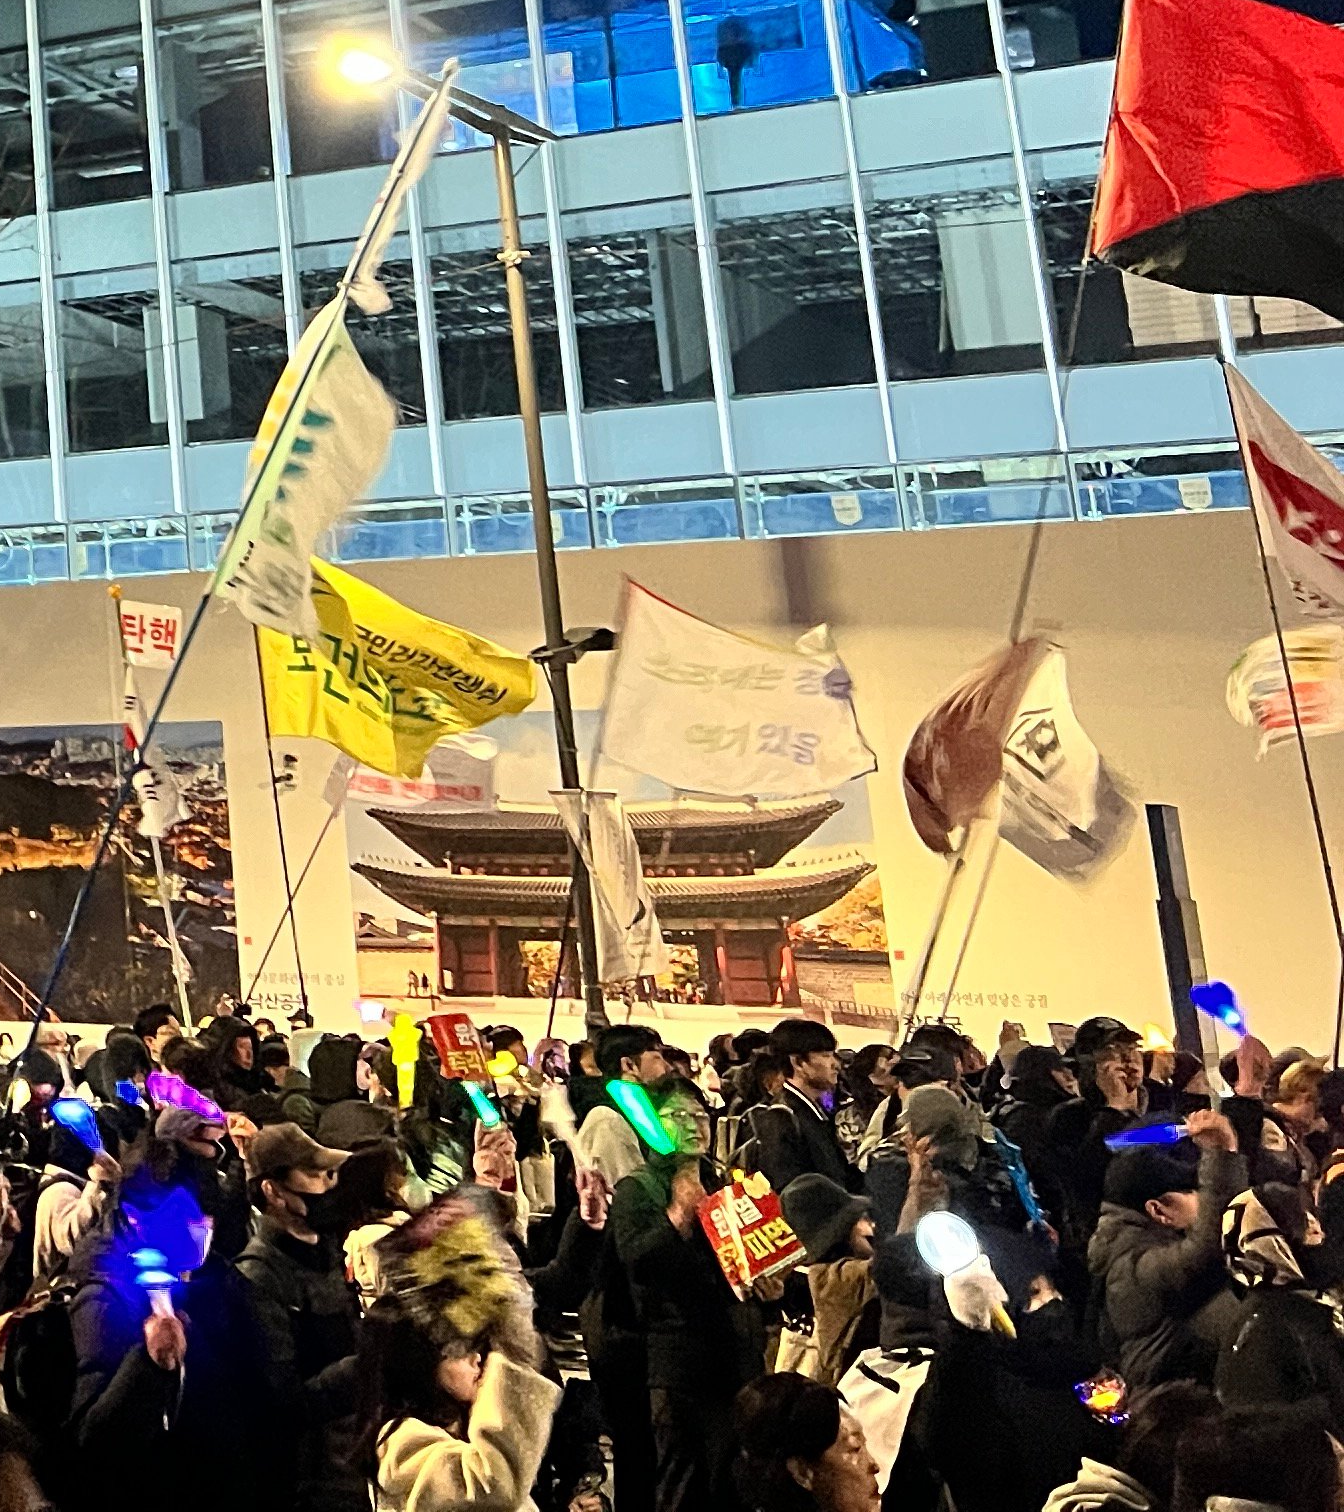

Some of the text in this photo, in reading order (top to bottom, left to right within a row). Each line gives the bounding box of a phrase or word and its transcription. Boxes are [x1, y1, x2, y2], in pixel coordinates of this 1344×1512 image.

[121, 614, 177, 661] 탄핵
[710, 1193, 764, 1240] 윤열
[742, 1216, 798, 1260] 파면
